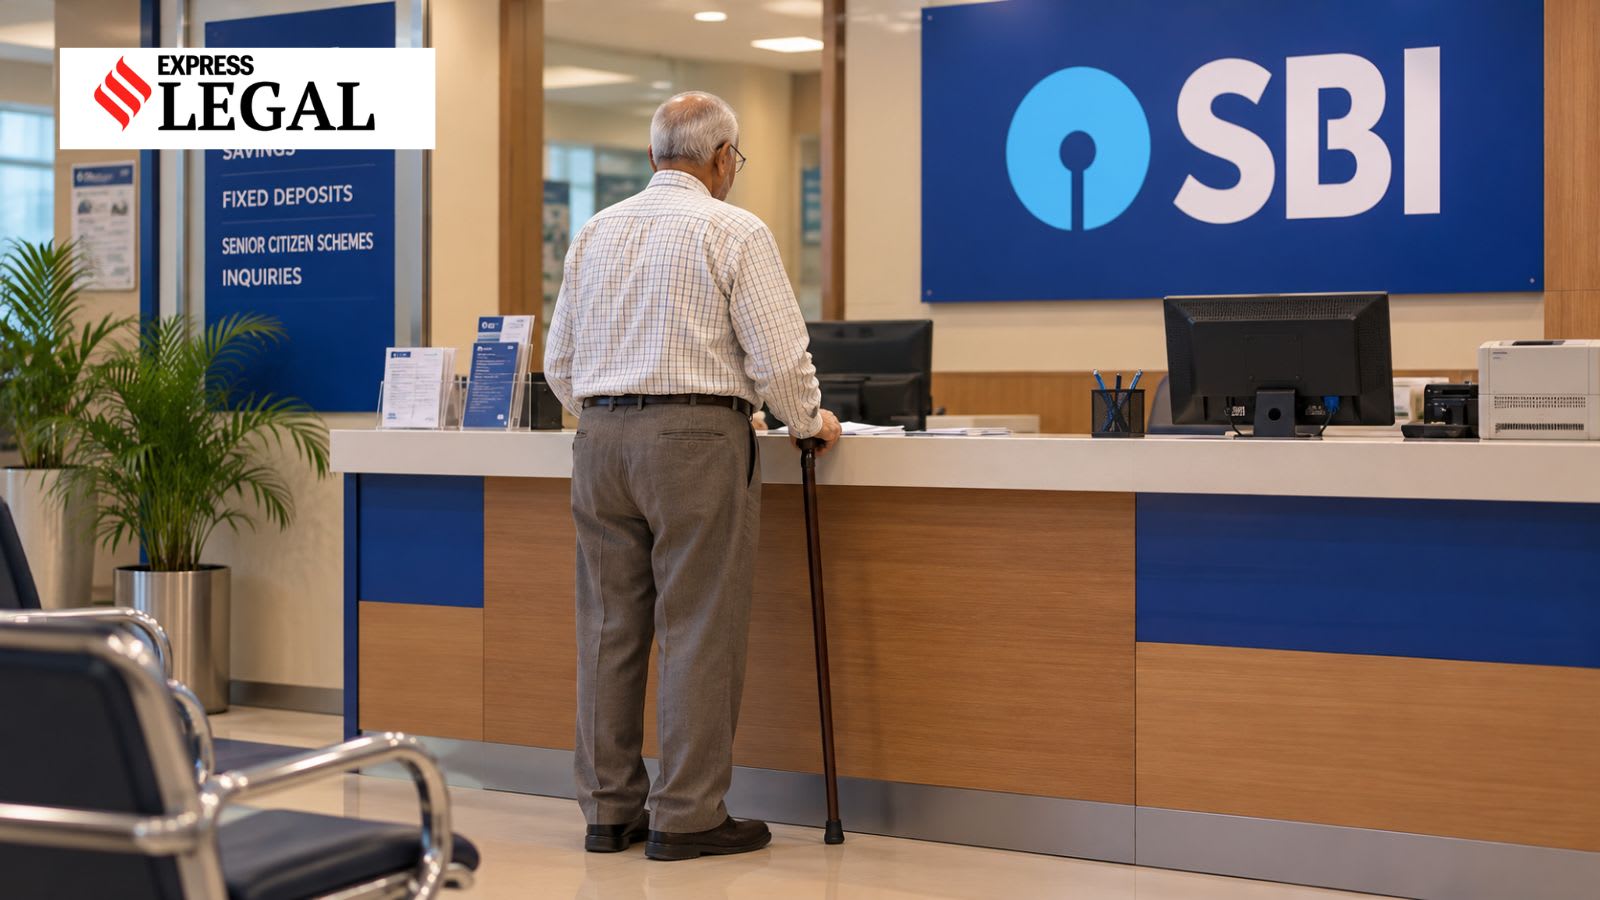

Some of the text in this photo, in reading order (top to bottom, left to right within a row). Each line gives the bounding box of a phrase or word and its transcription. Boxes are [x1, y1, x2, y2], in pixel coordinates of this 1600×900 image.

[1173, 46, 1441, 224] SBI
[222, 184, 353, 209] FIXED DEPOSITS
[222, 231, 374, 255] SENIOR CITIZEN SCHEMES
[222, 266, 302, 288] INQUIRIES
